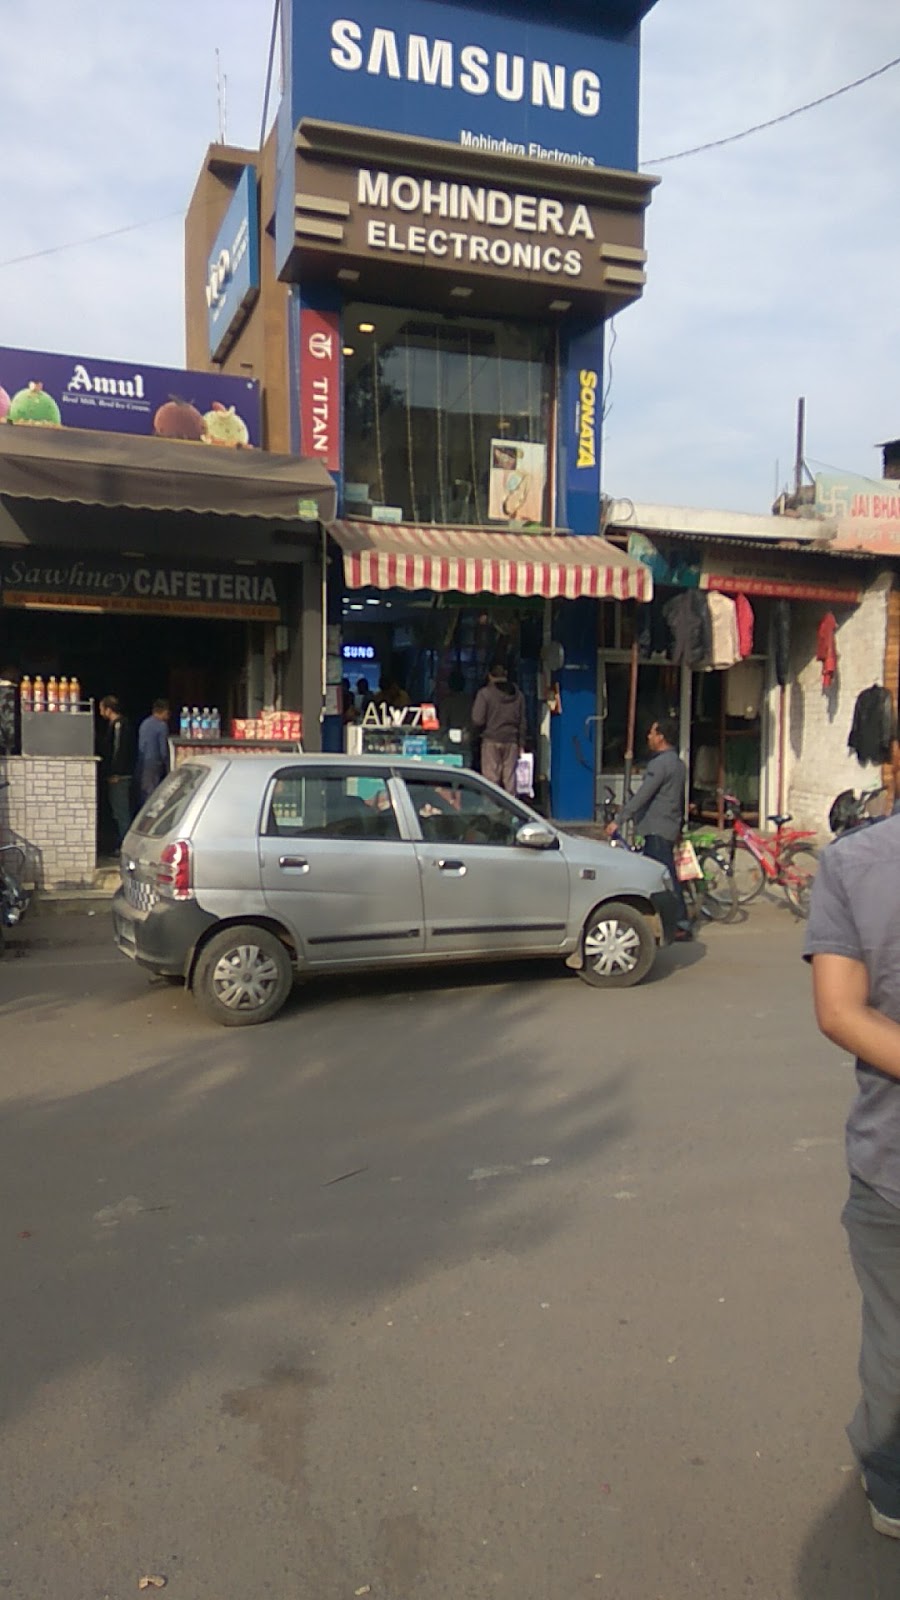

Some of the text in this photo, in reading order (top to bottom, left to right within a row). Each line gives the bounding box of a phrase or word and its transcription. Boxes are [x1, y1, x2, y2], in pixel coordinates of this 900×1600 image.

[330, 18, 601, 118] SAMSUNG
[460, 130, 596, 167] Mohindera Electronics
[356, 168, 596, 240] MOHINDERA
[367, 219, 582, 276] ELECTRONICS
[67, 364, 144, 398] Amul
[312, 377, 328, 452] TITAN
[576, 369, 598, 469] SONATA
[851, 494, 869, 518] JAI
[5, 561, 278, 602] Sawhney CAFETERIA
